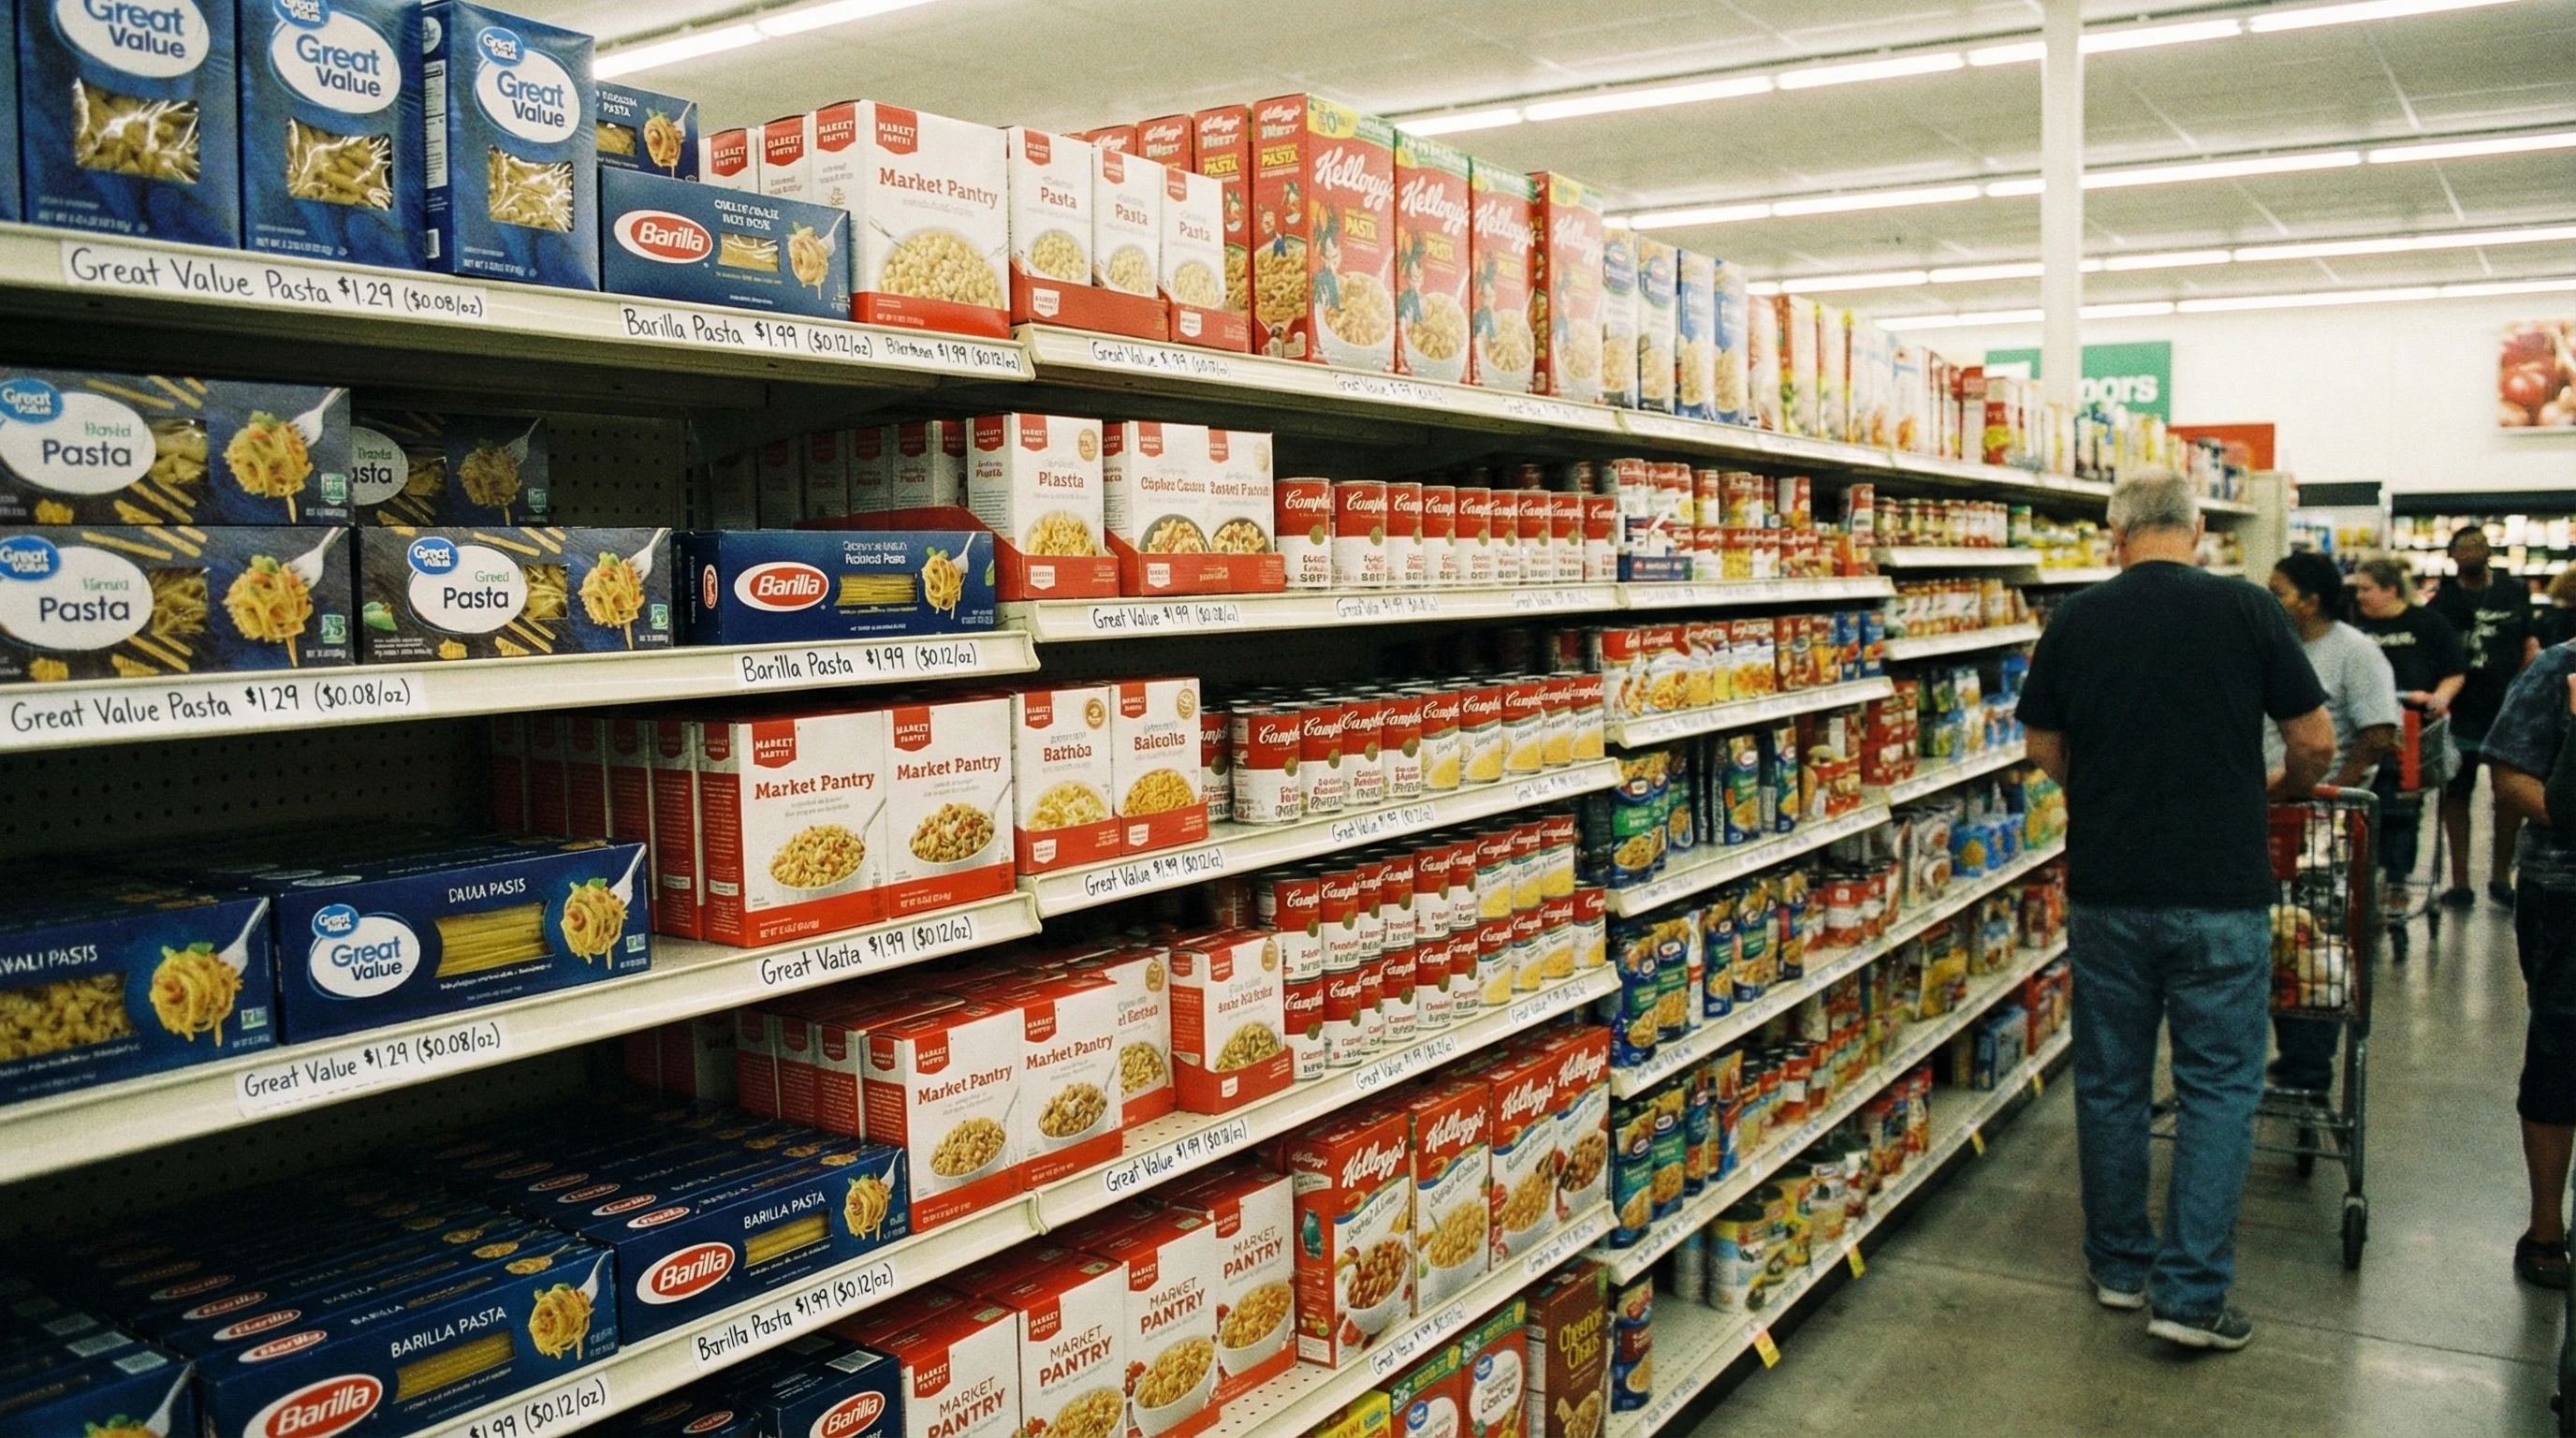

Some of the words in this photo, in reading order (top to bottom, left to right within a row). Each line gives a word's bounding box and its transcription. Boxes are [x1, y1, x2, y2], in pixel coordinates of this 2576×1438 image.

[83, 0, 184, 37] Great
[109, 24, 185, 58] Value
[297, 34, 381, 76] Great
[315, 67, 382, 96] Value
[496, 71, 564, 108] Great
[513, 101, 565, 128] Value
[879, 167, 943, 196] Market
[946, 180, 998, 210] Pantry
[1041, 186, 1077, 210] Pasta
[1115, 204, 1149, 227] Pasta
[1178, 222, 1211, 243] Pasta
[638, 222, 705, 252] Barilla
[71, 247, 160, 286] Great
[169, 258, 254, 296] Value
[266, 271, 331, 303] Pasta
[338, 276, 393, 308] $1.29
[403, 286, 484, 318] ($0.08/oz)
[623, 309, 686, 342] Barilla
[693, 315, 745, 346] Pasta
[755, 321, 798, 350] $1.99
[807, 328, 873, 359] ($0.12/oz)
[42, 437, 132, 467] Pasta
[443, 586, 509, 610] Pasta
[757, 575, 820, 597] Barilla
[39, 594, 131, 624] Pasta
[1128, 608, 1161, 627] Value
[742, 655, 802, 682] Barilla
[807, 653, 854, 678] Pasta
[867, 646, 904, 672] $1.99
[915, 641, 977, 669] ($0.12/oz)
[11, 699, 84, 732] Great
[94, 697, 161, 726] Value
[168, 691, 231, 721] Pasta
[246, 683, 299, 712] $1.29
[315, 677, 411, 712] ($0.08/oz)
[754, 778, 816, 800] Market
[821, 771, 874, 794] Pantry
[897, 759, 950, 781] Market
[955, 755, 1002, 775] Pantry
[331, 935, 402, 968] Great
[761, 958, 812, 986] Great
[869, 931, 905, 960] $1.99
[351, 960, 402, 982] Value
[244, 1065, 300, 1097] Great
[305, 1059, 357, 1083] Value
[363, 1042, 409, 1068] $1.29
[417, 1021, 501, 1064] ($0.08/oz)
[1025, 1047, 1072, 1071] Market
[1074, 1035, 1114, 1059] Pantry
[917, 1078, 970, 1106] Market
[970, 1064, 1013, 1092] Pantry
[1426, 1106, 1486, 1153] Kellogg's
[1105, 1163, 1139, 1193] Great
[1142, 1152, 1175, 1180] Value
[1341, 1136, 1407, 1189] Kellogg's
[743, 1205, 789, 1230] BARILLA
[792, 1192, 826, 1215] PASTA
[1223, 1236, 1283, 1280] PANTRY
[1233, 1225, 1277, 1255] MARKET
[659, 1251, 726, 1292] Barilla
[752, 1310, 794, 1342] Pasta
[796, 1290, 829, 1316] $1.99
[833, 1263, 895, 1309] ($0.12/oz)
[1140, 1287, 1206, 1334] PANTRY
[1149, 1277, 1197, 1311] MARKET
[390, 1326, 456, 1359] BARILLA
[459, 1307, 506, 1335] PASTA
[1050, 1324, 1103, 1361] MARKET
[1039, 1336, 1113, 1388] PANTRY
[276, 1386, 371, 1438] Barilla
[524, 1379, 606, 1434] ($0.12/oz)
[928, 1387, 1006, 1438] PANTRY
[939, 1376, 996, 1417] MARKET
[827, 1398, 879, 1433] Barilla
